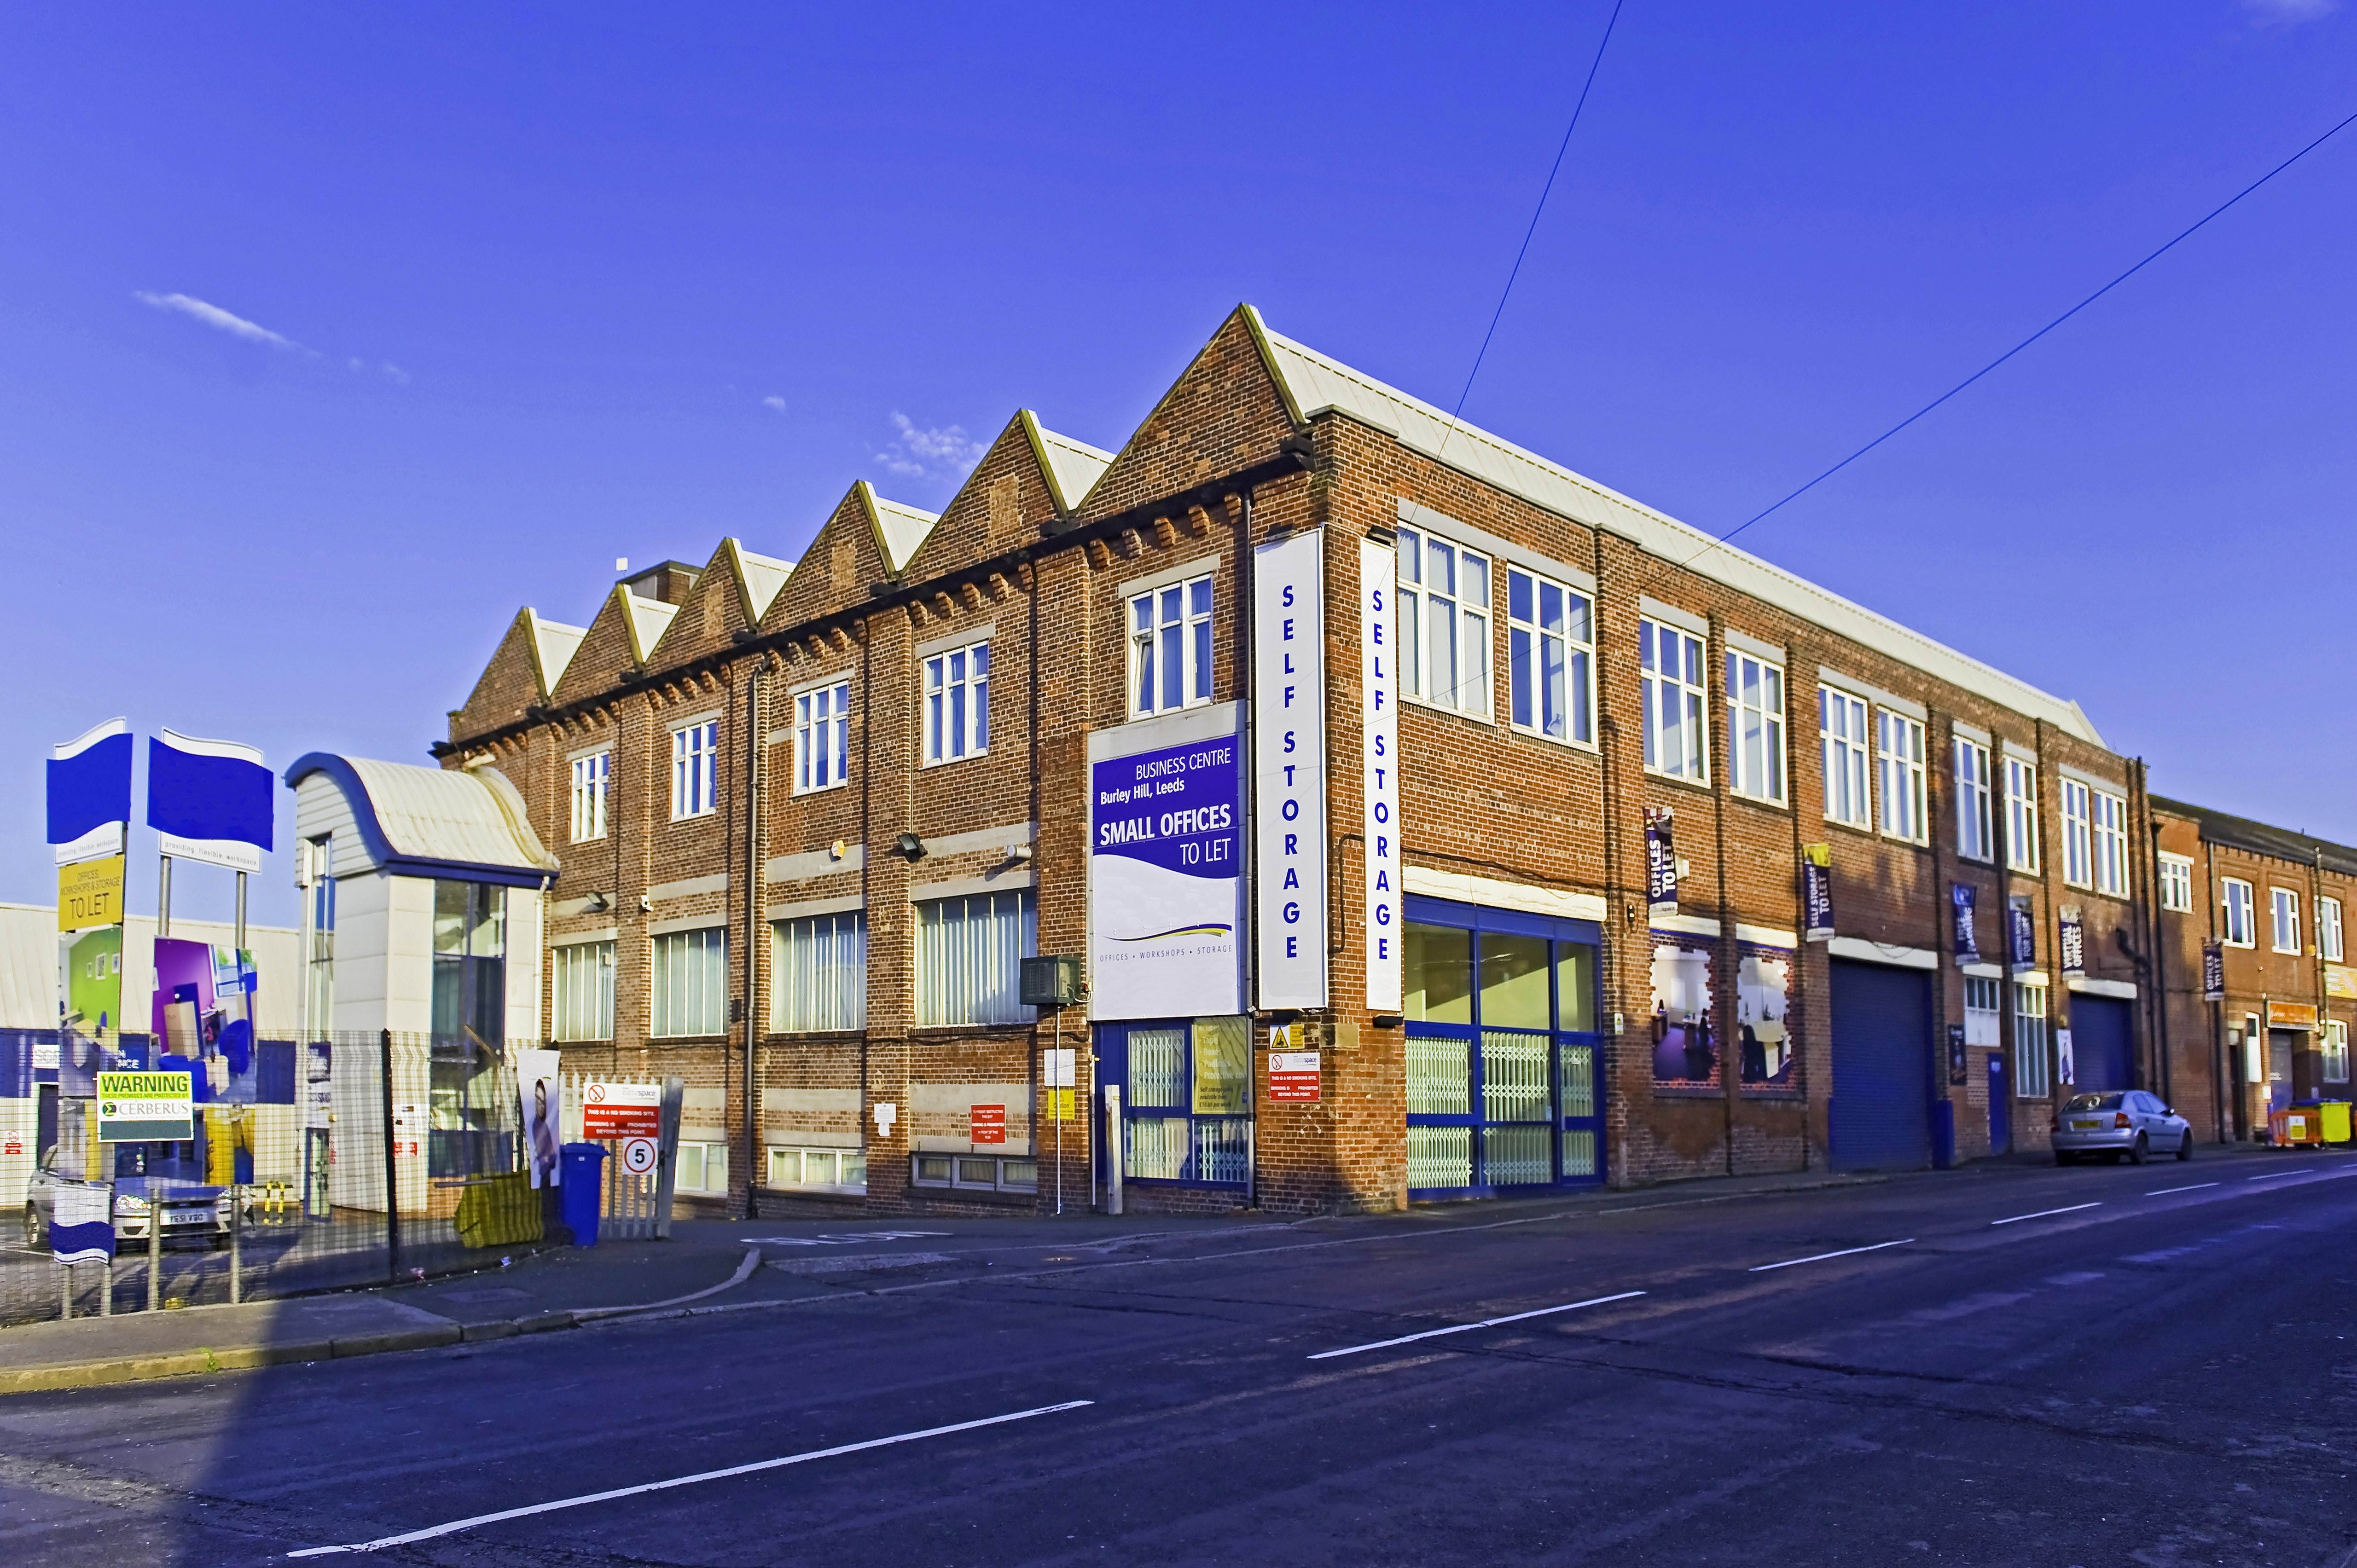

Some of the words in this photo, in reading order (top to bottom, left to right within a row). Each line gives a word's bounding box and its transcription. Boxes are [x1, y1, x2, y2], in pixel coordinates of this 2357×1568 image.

[1282, 585, 1295, 708] SELF
[1373, 590, 1383, 711] SELF
[1136, 756, 1185, 780] BUSINESS
[1189, 747, 1231, 770] CENTRE
[1100, 788, 1131, 805] Burley
[1133, 783, 1153, 799] Hill,
[1156, 777, 1185, 795] Leeds
[1100, 816, 1155, 845] SMALL
[1160, 804, 1231, 837] OFFICES
[165, 841, 195, 854] providing
[198, 847, 222, 859] flexible
[226, 855, 257, 866] workspace
[1180, 842, 1200, 865] TO
[1206, 838, 1231, 862] LET
[1282, 731, 1300, 959] STORAGE
[1375, 735, 1390, 960] STORAGE
[1662, 843, 1676, 870] LET
[95, 875, 121, 889] STORAGE
[1649, 839, 1662, 898] OFFICES
[1662, 871, 1676, 893] TO
[1809, 866, 1819, 906] STORAGE
[1819, 876, 1829, 897] LET
[70, 897, 84, 920] TO
[87, 892, 110, 916] LET
[1819, 897, 1830, 915] TO
[1100, 953, 1129, 962] OFFICES
[1140, 948, 1185, 959] WORKSHOPS
[1197, 944, 1232, 955] STORAGE
[2023, 939, 2031, 957] FOR
[2062, 925, 2072, 969] VIRTUAL
[2072, 926, 2083, 967] OFFICES
[1202, 1036, 1219, 1046] Tape
[101, 1076, 187, 1092] WARNING
[119, 1102, 189, 1115] CERBERUS
[635, 1148, 645, 1164] 5
